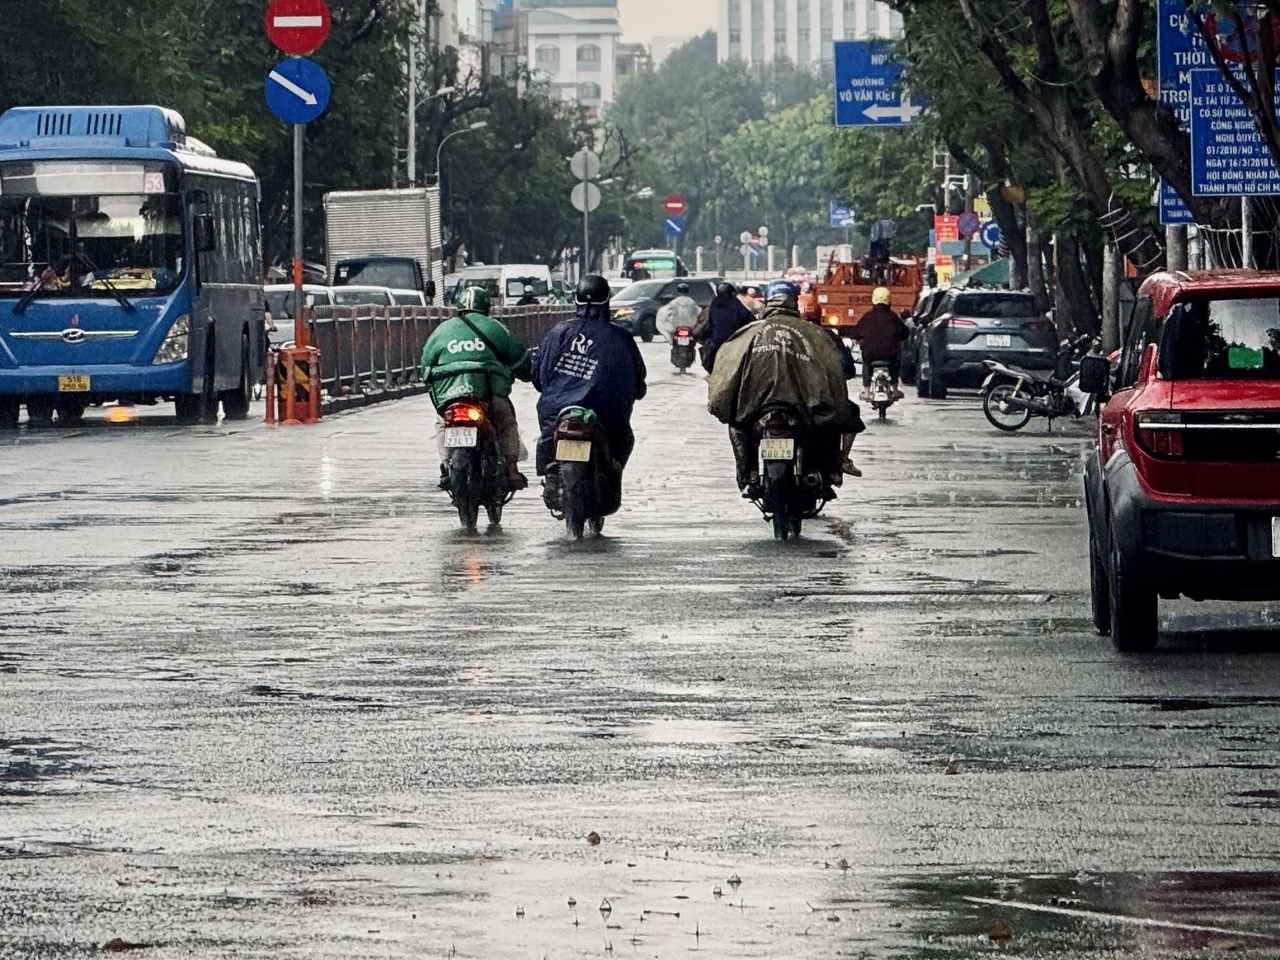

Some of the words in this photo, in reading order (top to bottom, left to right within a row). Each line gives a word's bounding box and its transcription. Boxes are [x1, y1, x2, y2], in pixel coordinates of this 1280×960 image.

[854, 89, 873, 101] VĂN
[1229, 158, 1269, 167] 16/3/2018
[147, 174, 162, 191] 53
[1198, 182, 1225, 193] THÀNH
[447, 338, 486, 353] Grab
[447, 382, 474, 397] Grab
